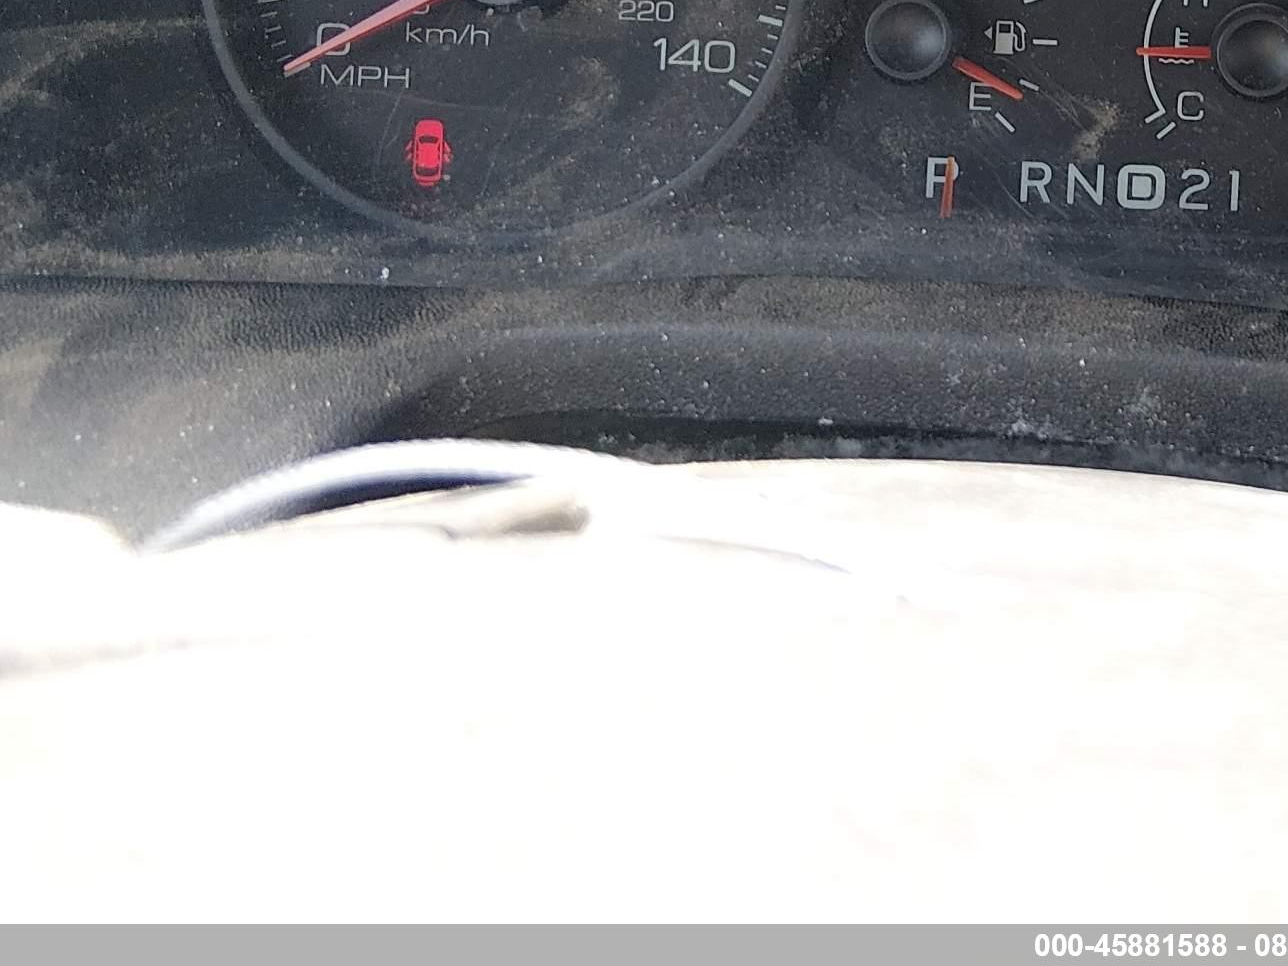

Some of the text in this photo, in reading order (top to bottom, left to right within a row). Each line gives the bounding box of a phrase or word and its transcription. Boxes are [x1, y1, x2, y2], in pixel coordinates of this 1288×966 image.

[617, 0, 674, 23] 220
[316, 23, 351, 56] 0
[406, 23, 491, 48] km/h
[653, 38, 735, 73] 140
[320, 64, 411, 89] MPH
[969, 82, 992, 110] E
[1177, 92, 1204, 121] C
